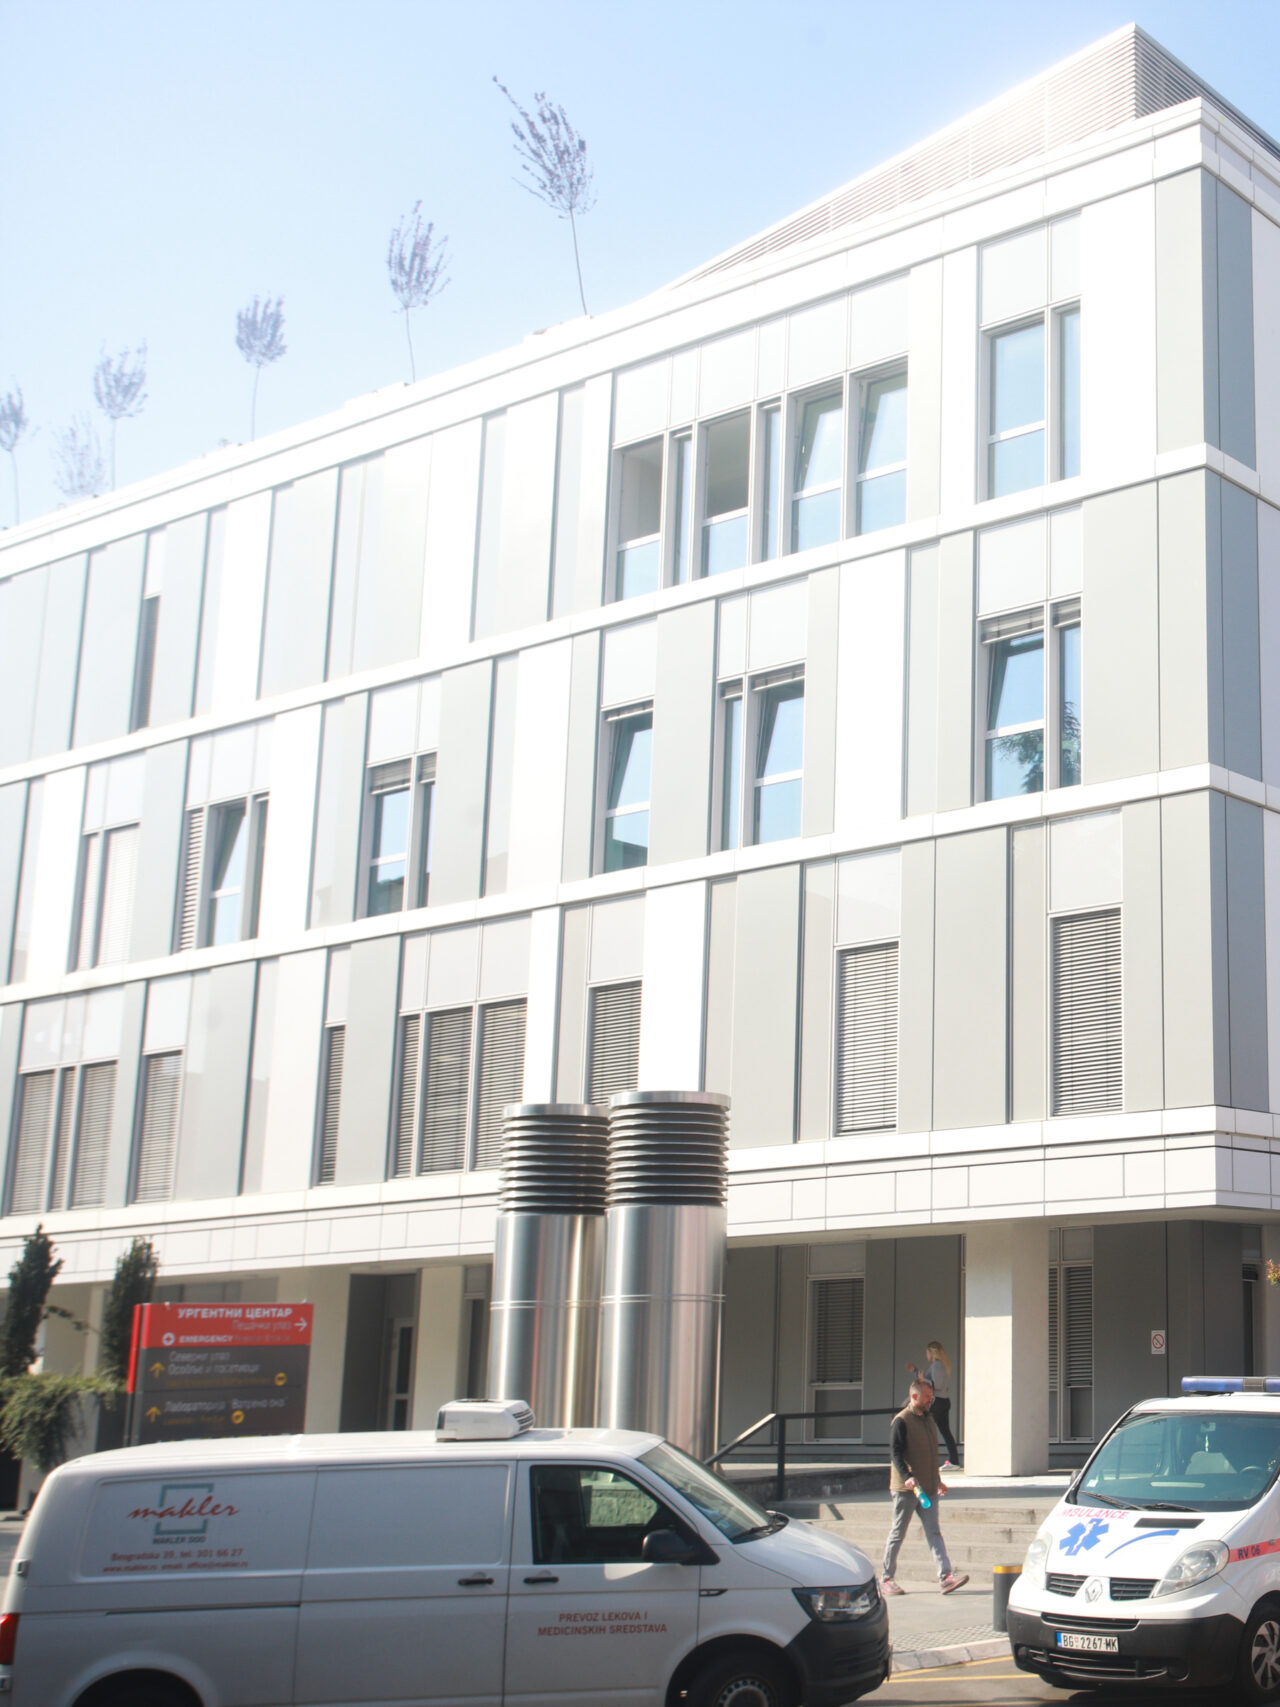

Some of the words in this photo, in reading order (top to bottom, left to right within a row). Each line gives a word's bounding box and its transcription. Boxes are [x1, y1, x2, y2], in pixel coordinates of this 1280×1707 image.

[178, 1307, 243, 1319] УРГЕНТНИ
[245, 1307, 293, 1319] ЦЕНТАР
[179, 1334, 234, 1343] EMERGENCY
[127, 1495, 240, 1519] makler
[1059, 1506, 1130, 1519] MBULANCE
[1238, 1548, 1249, 1560] RV
[1252, 1546, 1261, 1556] 06
[558, 1612, 599, 1623] PREVOZ
[602, 1611, 641, 1622] LEKOVA
[644, 1611, 648, 1620] I
[538, 1624, 606, 1637] MEDICINSKIH
[609, 1623, 668, 1634] SREDSTAVA
[1063, 1635, 1074, 1647] BG
